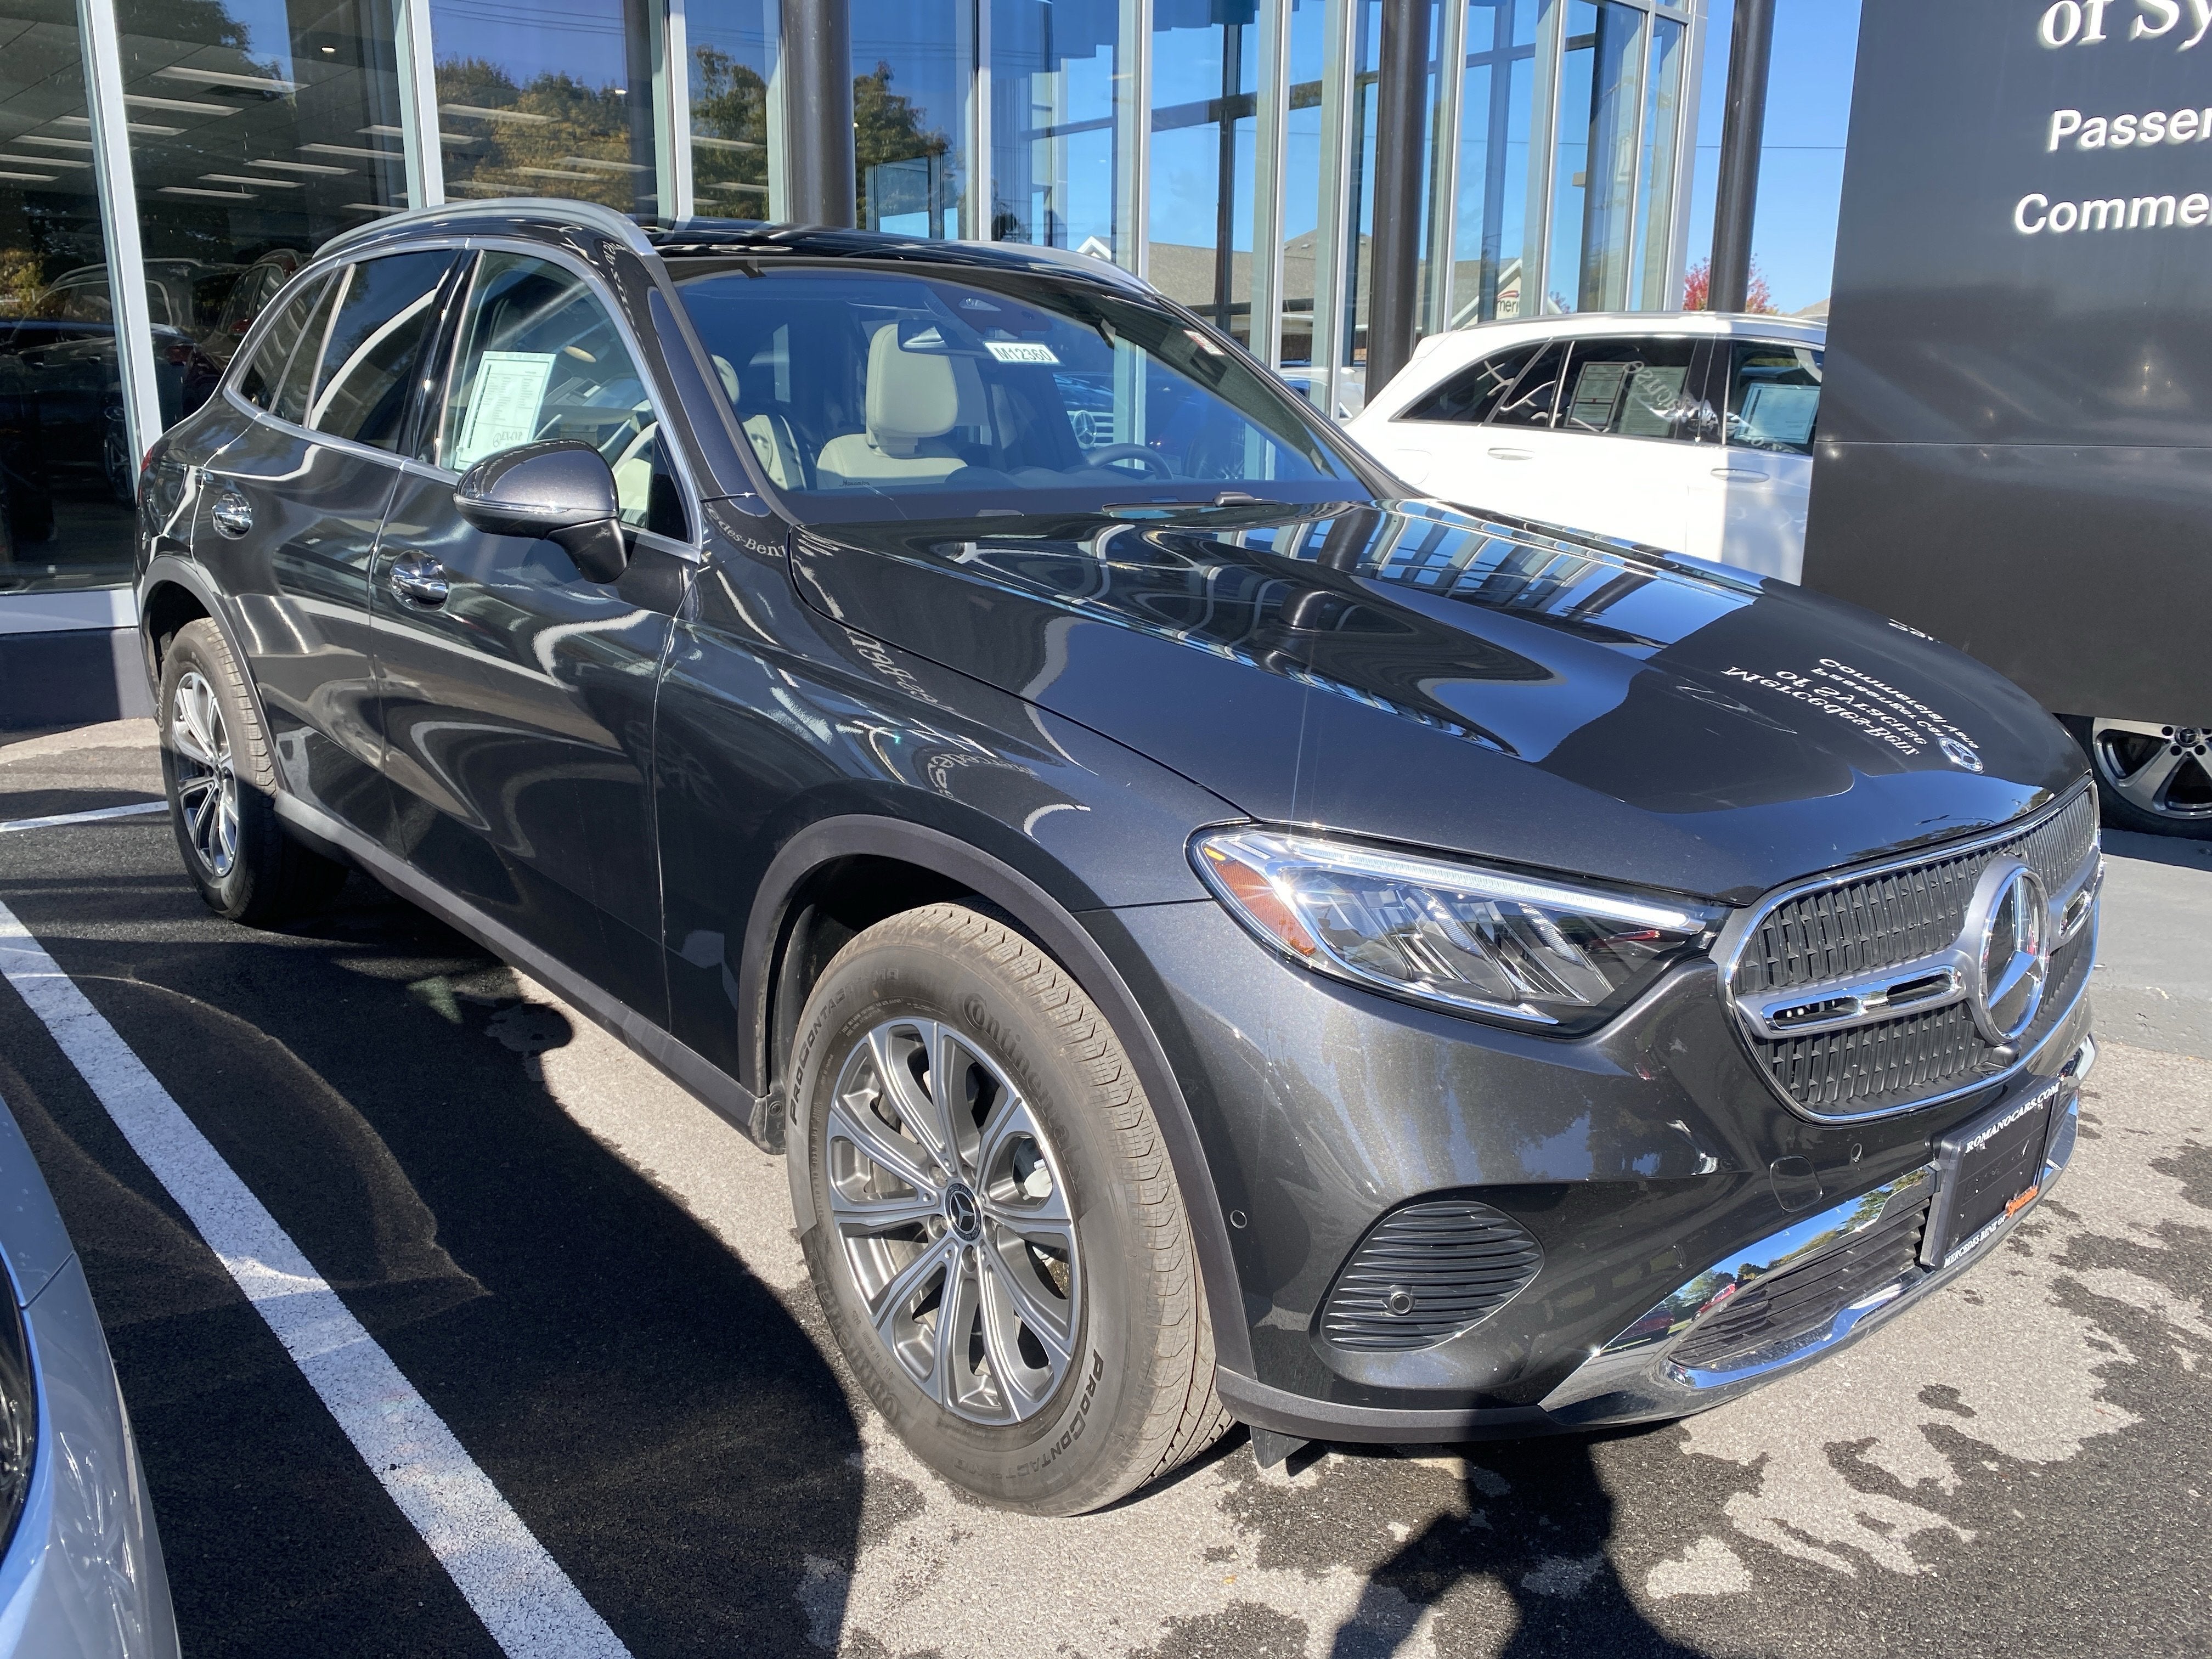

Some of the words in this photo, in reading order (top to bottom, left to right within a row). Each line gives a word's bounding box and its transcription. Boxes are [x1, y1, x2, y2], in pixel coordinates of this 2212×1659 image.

[2038, 0, 2115, 49] of
[2012, 192, 2212, 235] Comme
[994, 347, 1053, 362] M12360
[1965, 1081, 2061, 1154] ROMANOCARS.COM
[1943, 1234, 1980, 1269] MERCEDES
[1979, 1220, 1998, 1242] BENZ
